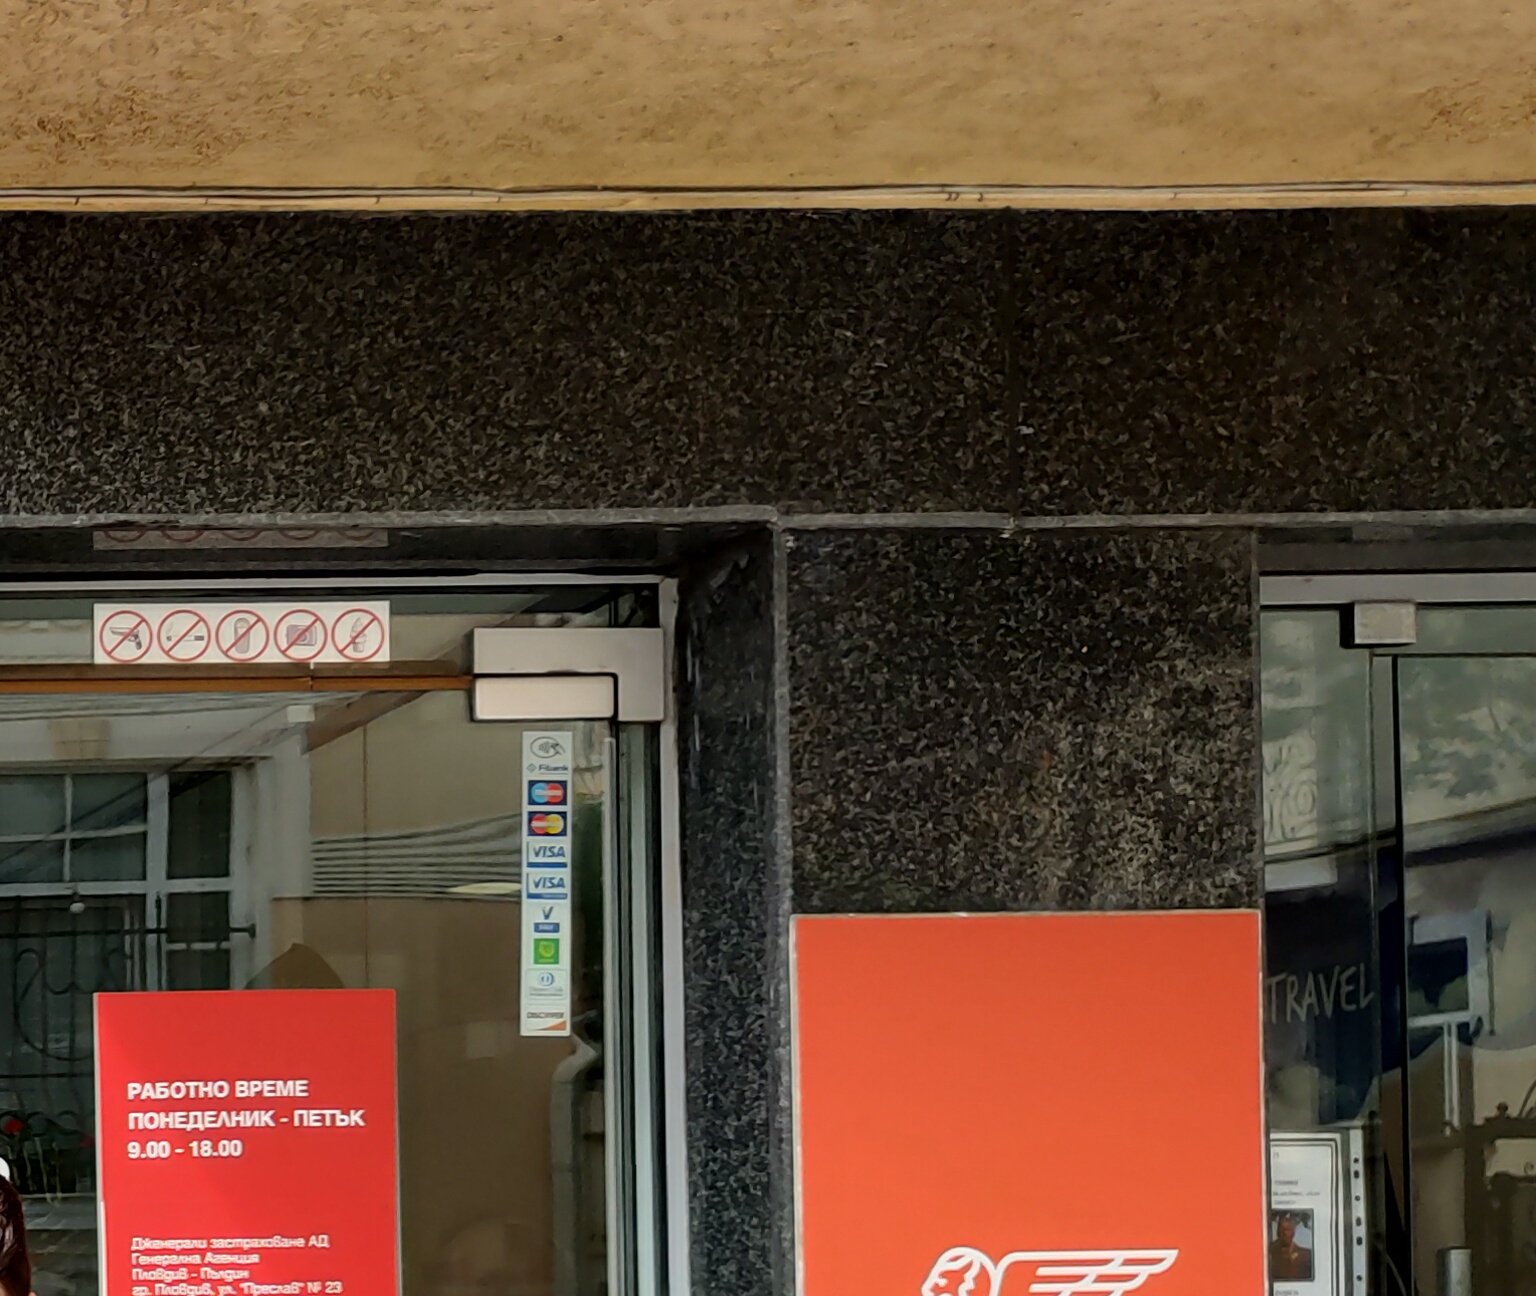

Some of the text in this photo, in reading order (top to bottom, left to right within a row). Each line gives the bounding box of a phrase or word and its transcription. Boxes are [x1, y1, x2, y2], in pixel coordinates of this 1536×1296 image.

[533, 846, 566, 858] VISA
[533, 877, 566, 889] VISA
[1266, 962, 1374, 1024] TRAVEL
[128, 1080, 309, 1100] РАБОТНО ВРЕМЕ
[128, 1110, 276, 1131] ПОНЕДЕЛНИК
[293, 1109, 365, 1127] ПЕТЪК
[128, 1141, 170, 1158] 9.00
[189, 1139, 243, 1157] 18.00
[308, 1234, 330, 1248] АД
[132, 1252, 202, 1267] Генерална
[132, 1268, 188, 1283] Пловдив
[325, 1281, 343, 1293] 23
